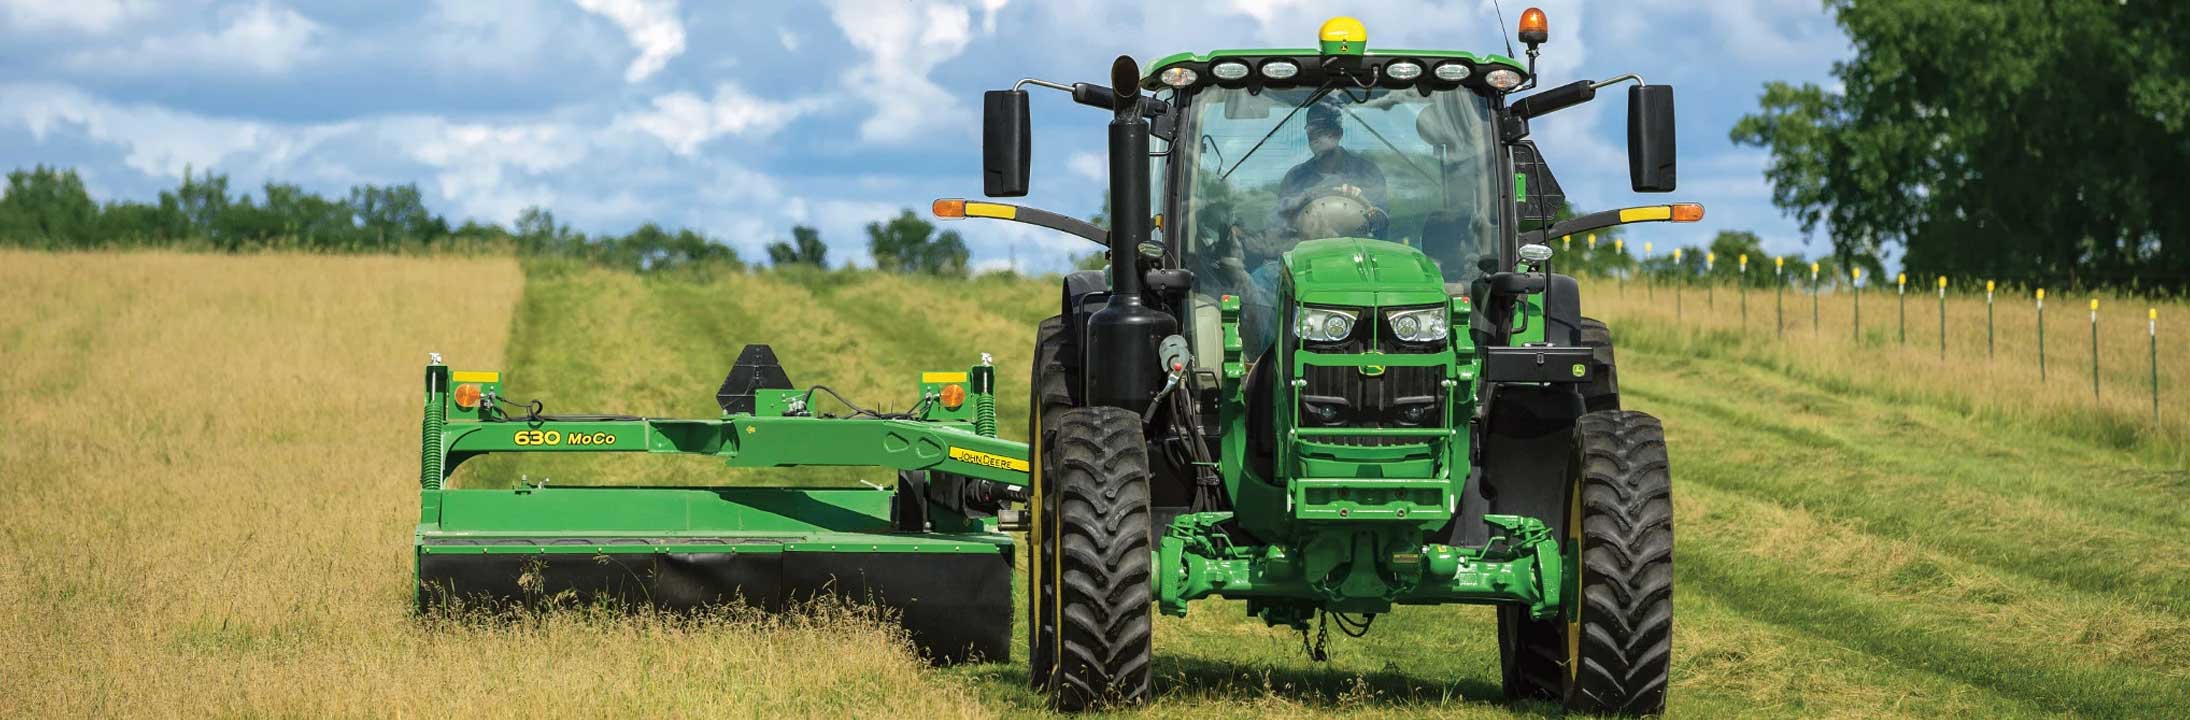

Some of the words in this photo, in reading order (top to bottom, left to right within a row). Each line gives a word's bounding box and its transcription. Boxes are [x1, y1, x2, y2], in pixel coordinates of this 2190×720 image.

[514, 430, 561, 446] 630
[567, 432, 616, 445] MoCo
[959, 451, 982, 465] JOHN
[983, 455, 1012, 469] DEERE
